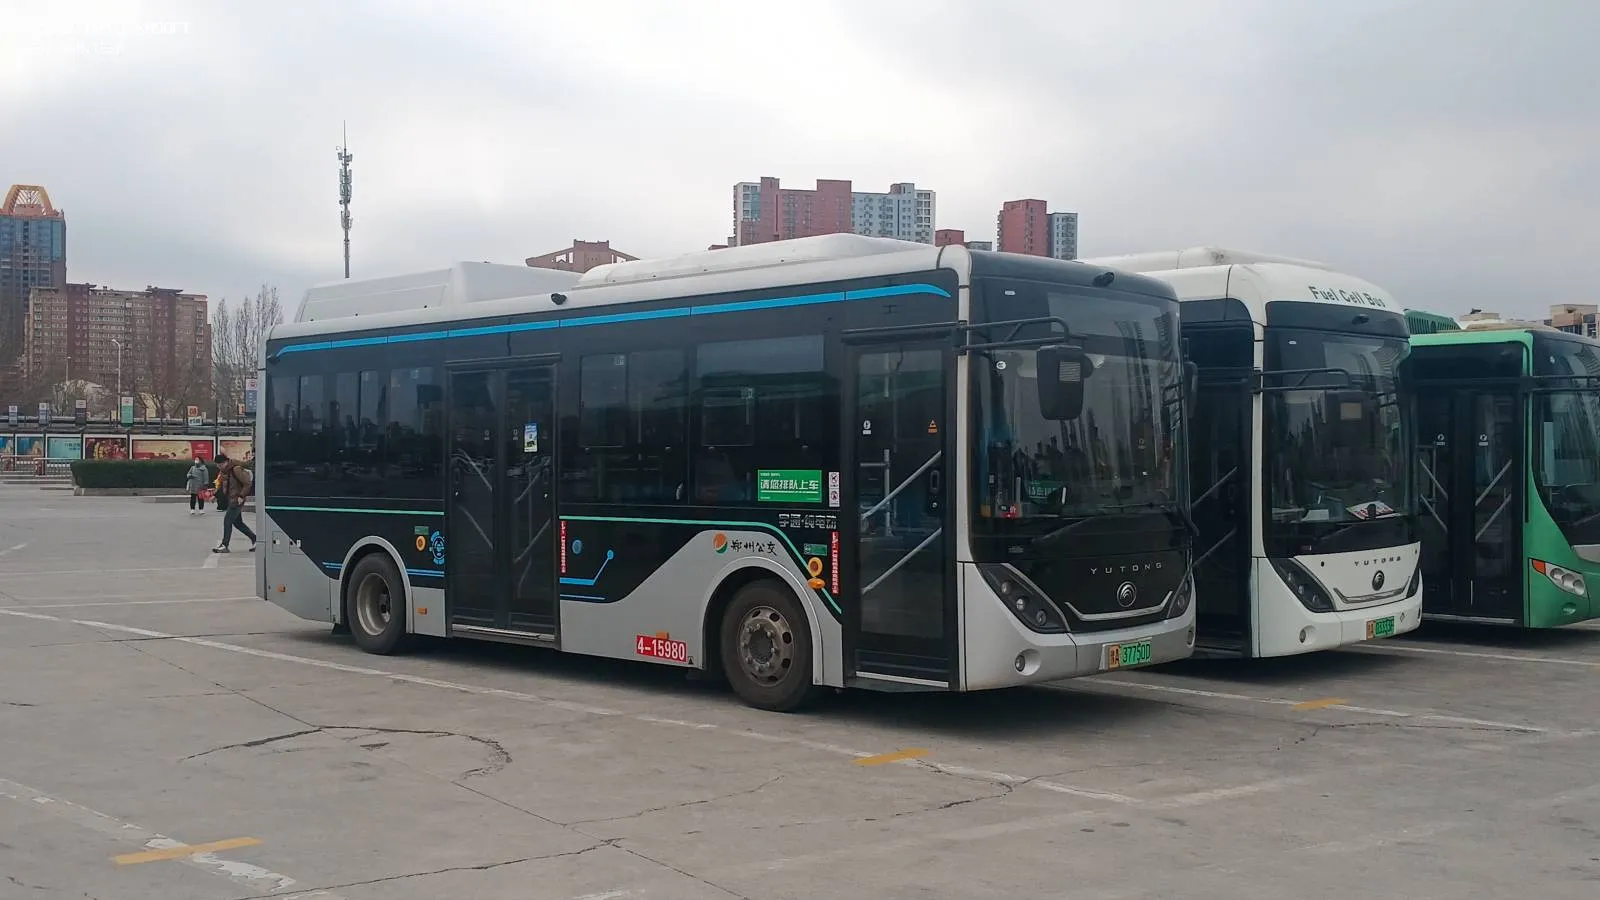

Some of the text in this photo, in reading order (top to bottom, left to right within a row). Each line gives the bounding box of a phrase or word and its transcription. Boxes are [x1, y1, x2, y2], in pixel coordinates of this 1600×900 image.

[1308, 285, 1387, 307] Fuel Cell Bus
[760, 479, 819, 490] 请您排队上车
[730, 539, 777, 556] 郑州公交
[1090, 562, 1162, 575] YUTONG
[1354, 556, 1401, 567] YUTONG
[637, 637, 685, 661] 4-15980
